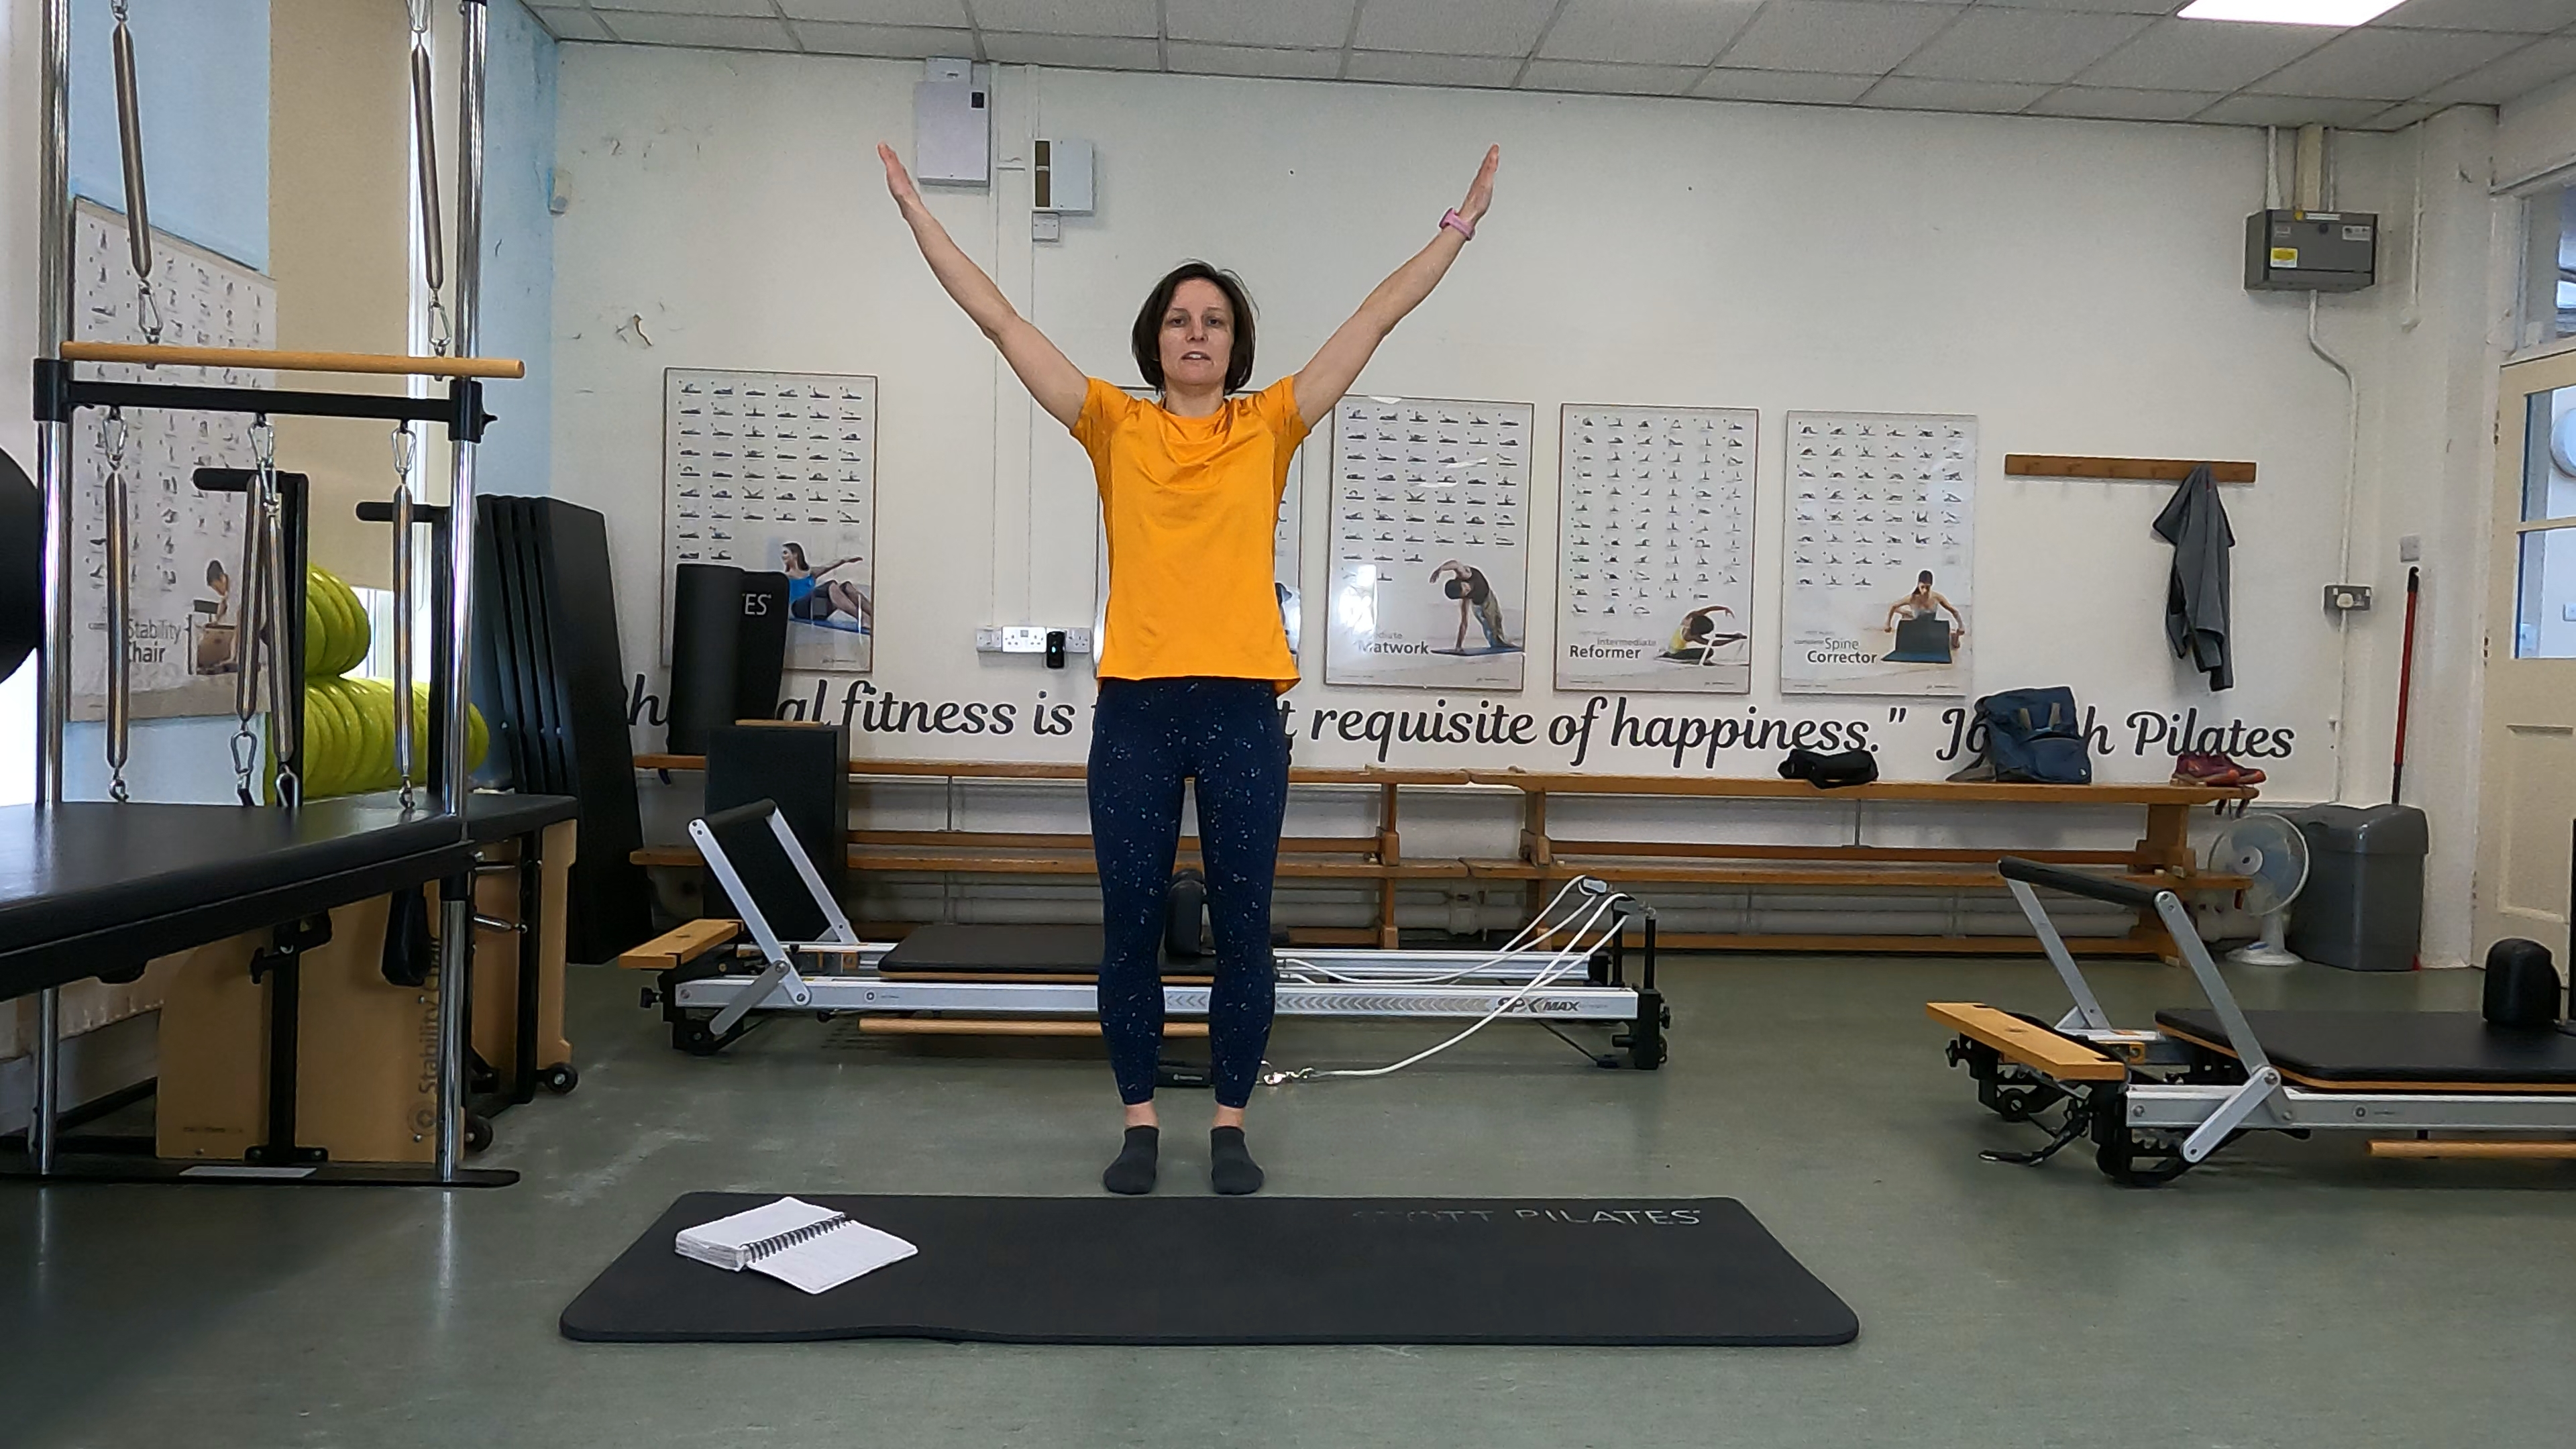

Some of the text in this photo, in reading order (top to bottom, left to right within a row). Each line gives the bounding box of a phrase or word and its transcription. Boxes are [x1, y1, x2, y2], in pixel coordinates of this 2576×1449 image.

[129, 641, 166, 663] hair
[1569, 644, 1642, 659] Reformer
[1824, 637, 1860, 652] Spine
[1807, 649, 1878, 663] Corrector
[841, 680, 1017, 735] fitness
[1033, 690, 1075, 736] is
[1310, 699, 1538, 763] requisite
[1548, 696, 1608, 766] of
[2126, 707, 2295, 759] Pilates
[1543, 1001, 1580, 1012] MAX
[1513, 1209, 1700, 1225] PILATES
